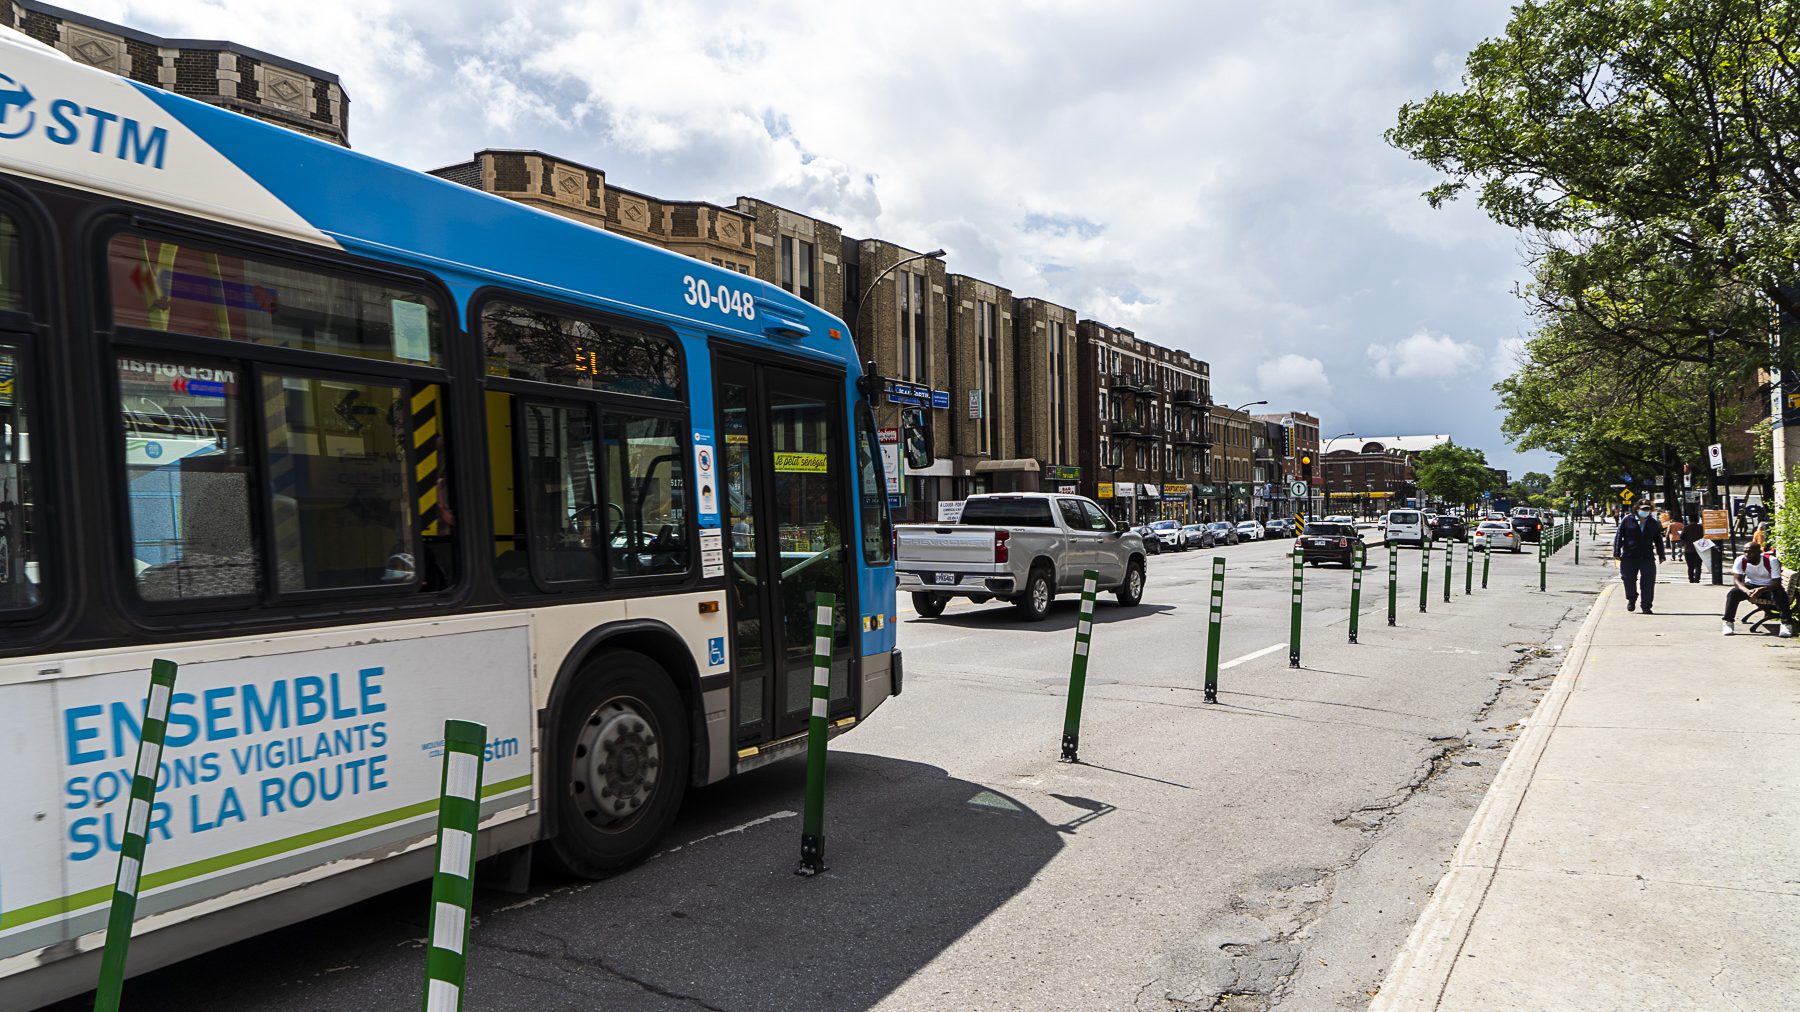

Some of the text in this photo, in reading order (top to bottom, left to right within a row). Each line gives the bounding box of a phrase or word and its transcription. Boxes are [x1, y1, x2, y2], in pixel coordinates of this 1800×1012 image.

[46, 99, 168, 169] STM
[684, 275, 756, 321] 30-048
[775, 455, 826, 469] le petit sénégal
[63, 667, 388, 766] ENSEMBLE
[231, 721, 388, 775] VIGILANTS
[484, 737, 519, 762] stm
[191, 787, 246, 834] LA
[261, 754, 388, 817] ROUTE
